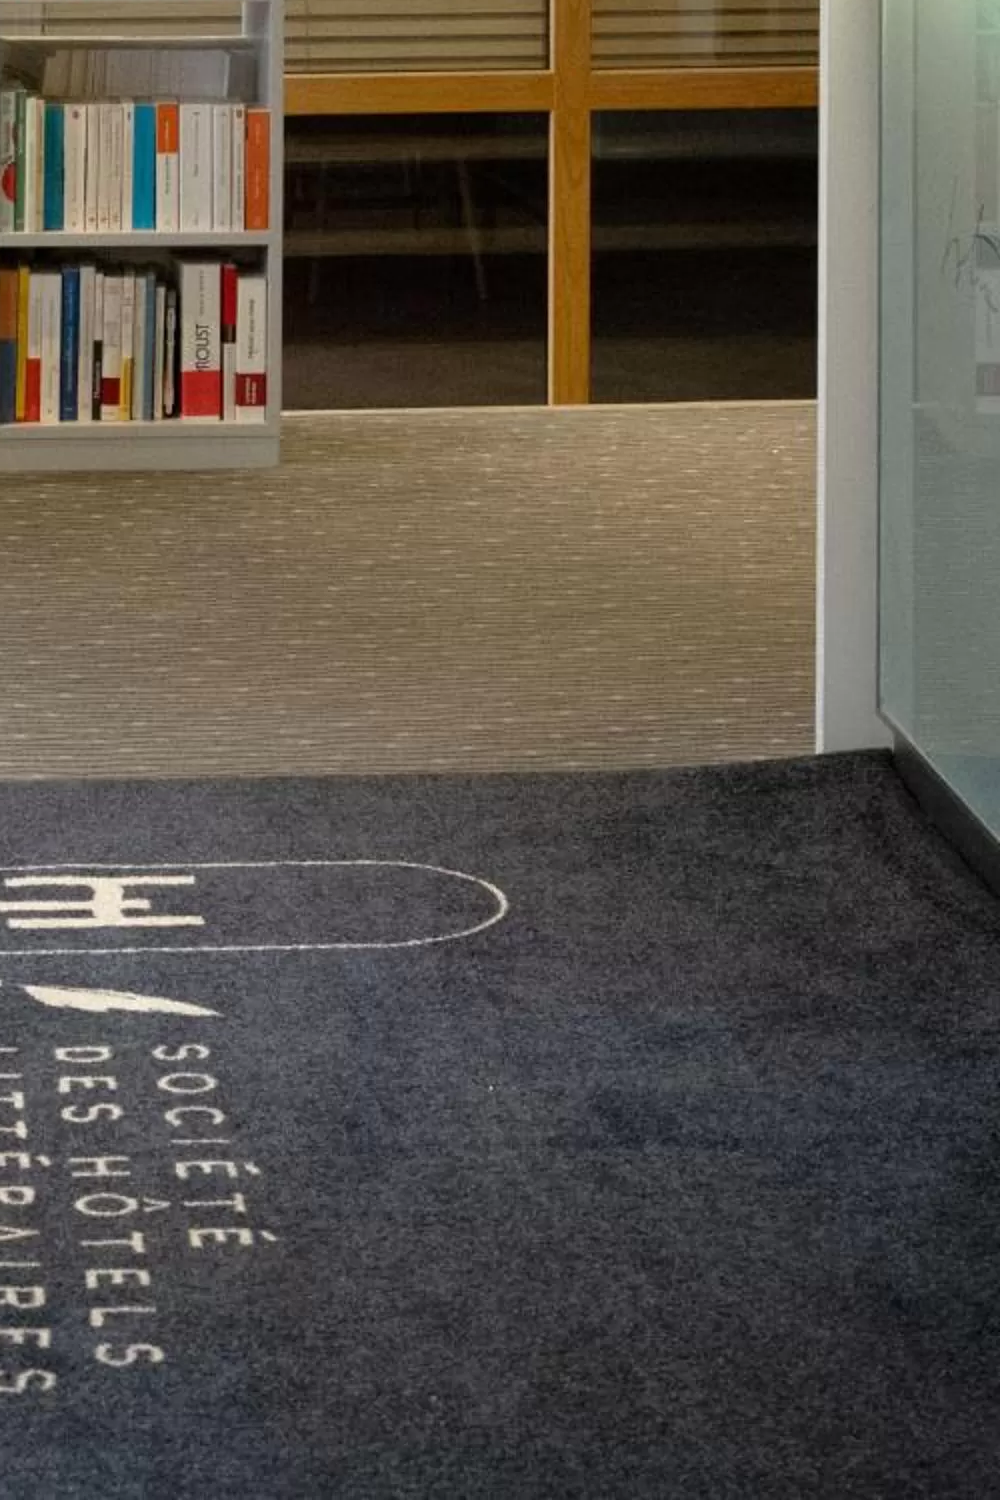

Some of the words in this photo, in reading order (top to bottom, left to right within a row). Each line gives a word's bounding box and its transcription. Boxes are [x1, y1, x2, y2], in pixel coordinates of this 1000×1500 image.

[194, 323, 210, 373] ROUST
[53, 1045, 124, 1124] DES
[151, 1043, 278, 1248] SOCIÉTÉ
[67, 1156, 171, 1367] HÔTELS
